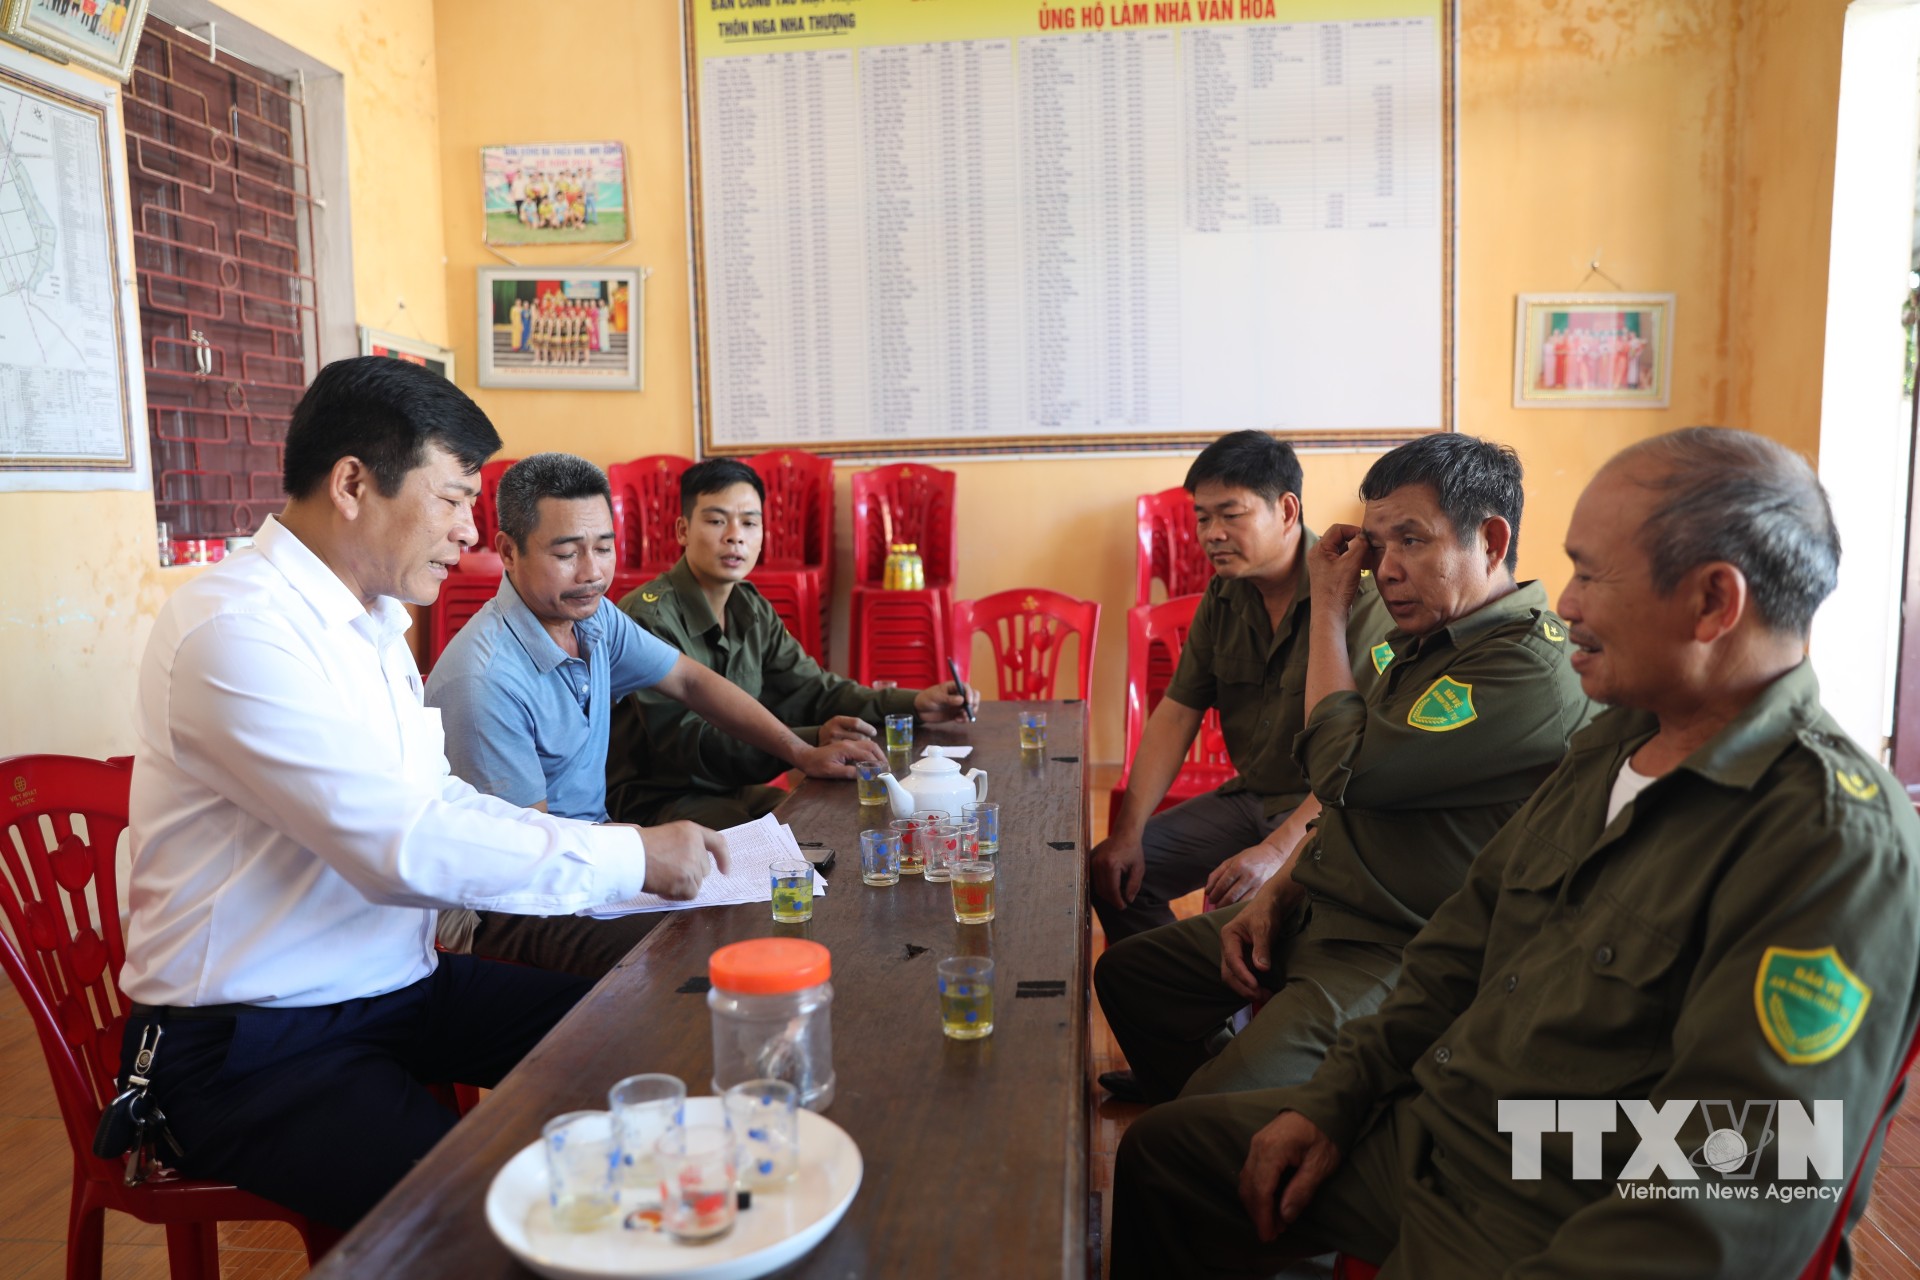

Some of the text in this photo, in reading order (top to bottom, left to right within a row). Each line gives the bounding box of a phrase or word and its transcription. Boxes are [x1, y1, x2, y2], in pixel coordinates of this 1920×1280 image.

[718, 13, 856, 37] THÔN NGA NHA THƯỢNG
[1082, 0, 1105, 32] HỘ
